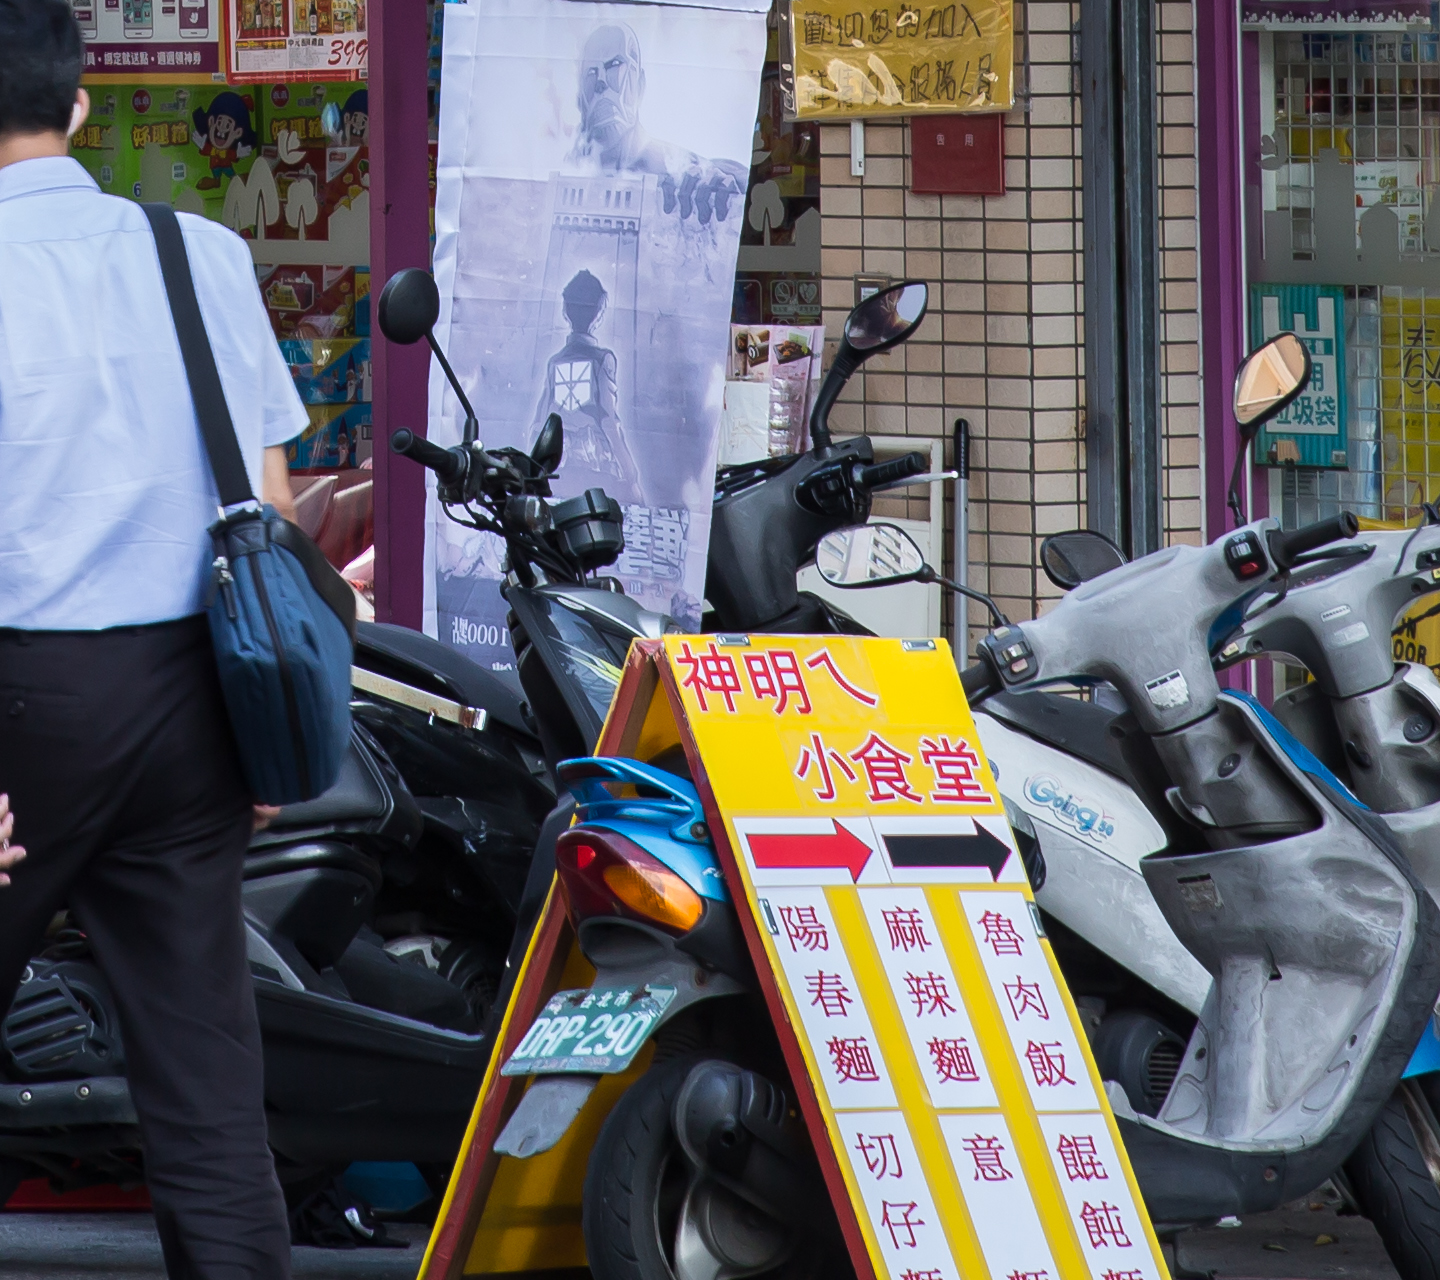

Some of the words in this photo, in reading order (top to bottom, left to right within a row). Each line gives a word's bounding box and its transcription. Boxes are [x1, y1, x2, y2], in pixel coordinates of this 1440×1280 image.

[793, 730, 994, 806] 小食堂
[579, 990, 633, 1009] 台北市
[777, 904, 880, 1084] 陽春麵
[885, 905, 980, 1084] 麻辣麵
[978, 908, 1077, 1088] 魯肉飯
[854, 1132, 943, 1280] 切仔
[961, 1133, 1048, 1280] 意
[1055, 1133, 1146, 1280] 餛飩
